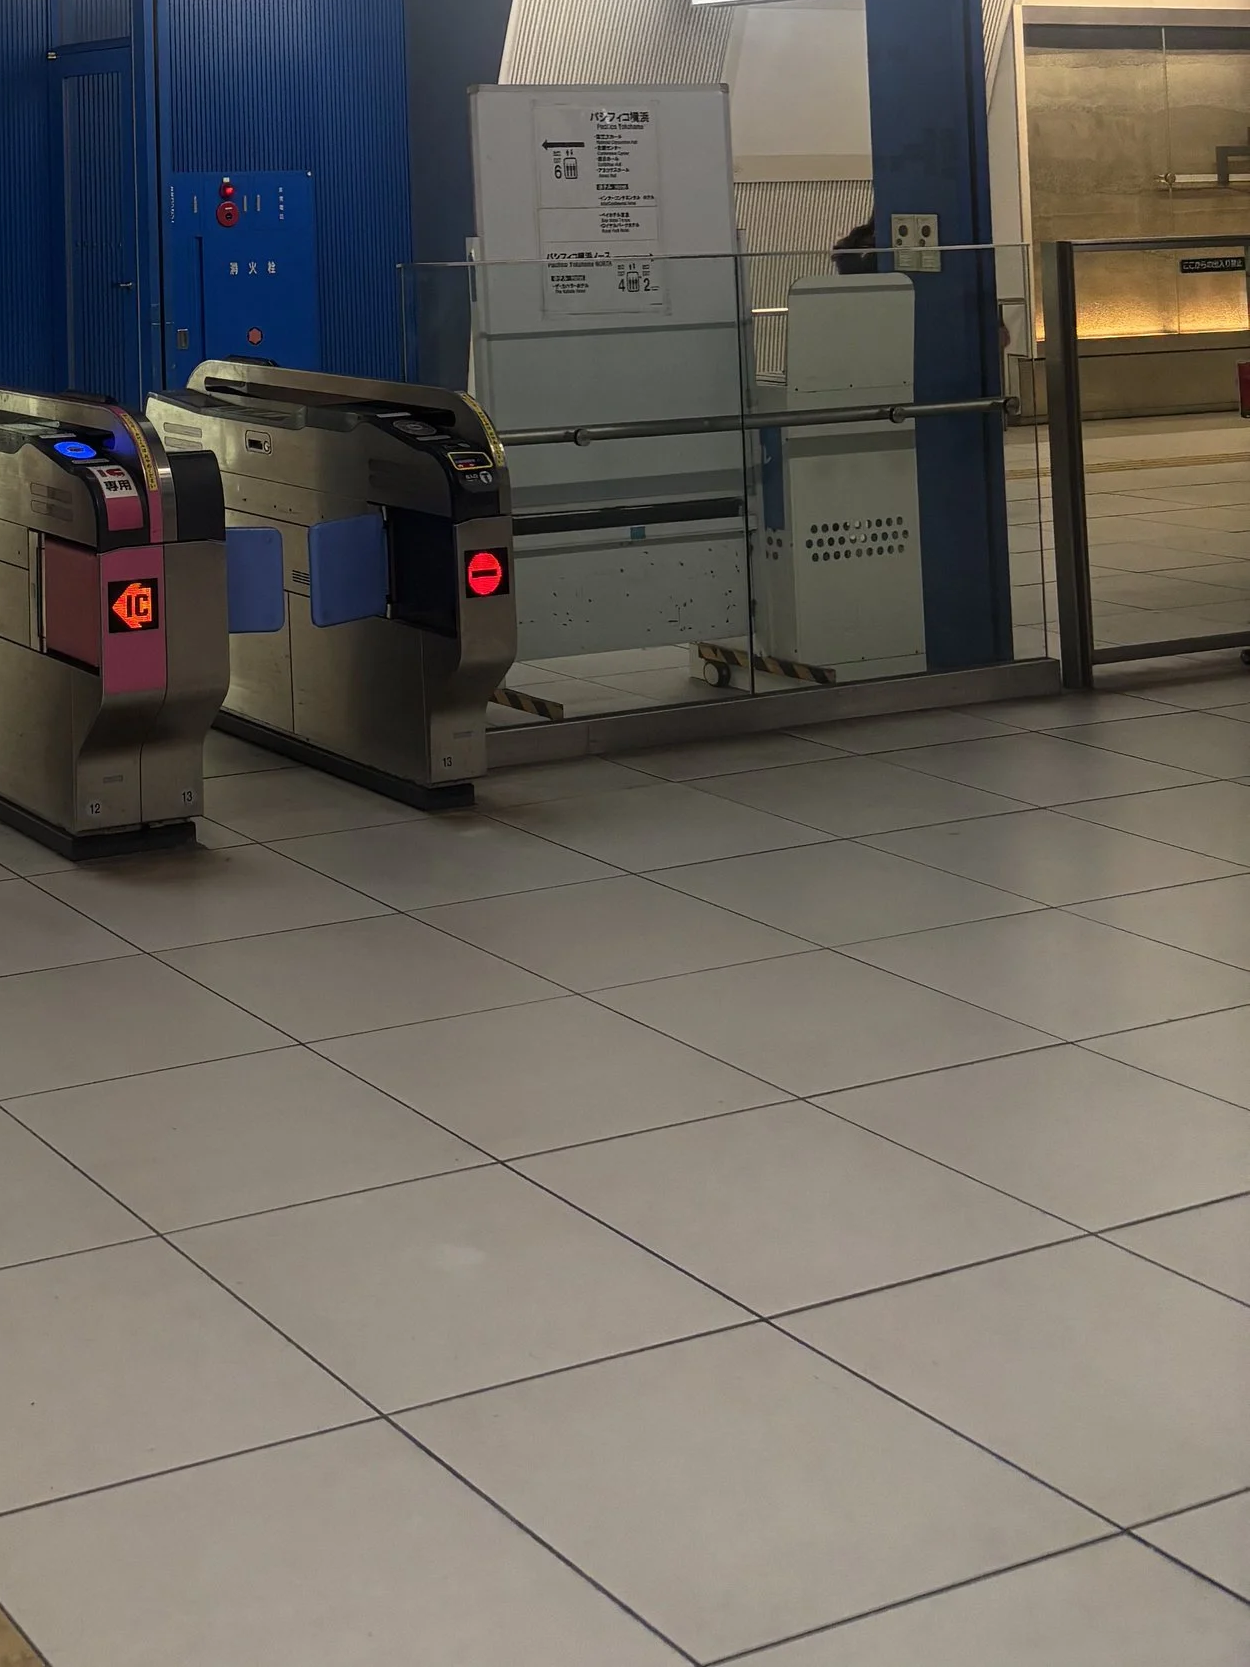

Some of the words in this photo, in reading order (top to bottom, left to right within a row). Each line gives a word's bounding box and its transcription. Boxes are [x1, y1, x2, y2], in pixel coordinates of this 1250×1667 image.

[590, 111, 650, 123] パシフィコ横浜
[554, 165, 562, 179] 6
[230, 260, 276, 276] 消火栓
[618, 278, 626, 292] 4
[643, 278, 651, 292] 2
[103, 479, 132, 492] 専用
[126, 594, 149, 618] IC
[442, 756, 453, 768] 13
[182, 790, 193, 803] 13
[90, 802, 101, 815] 12
